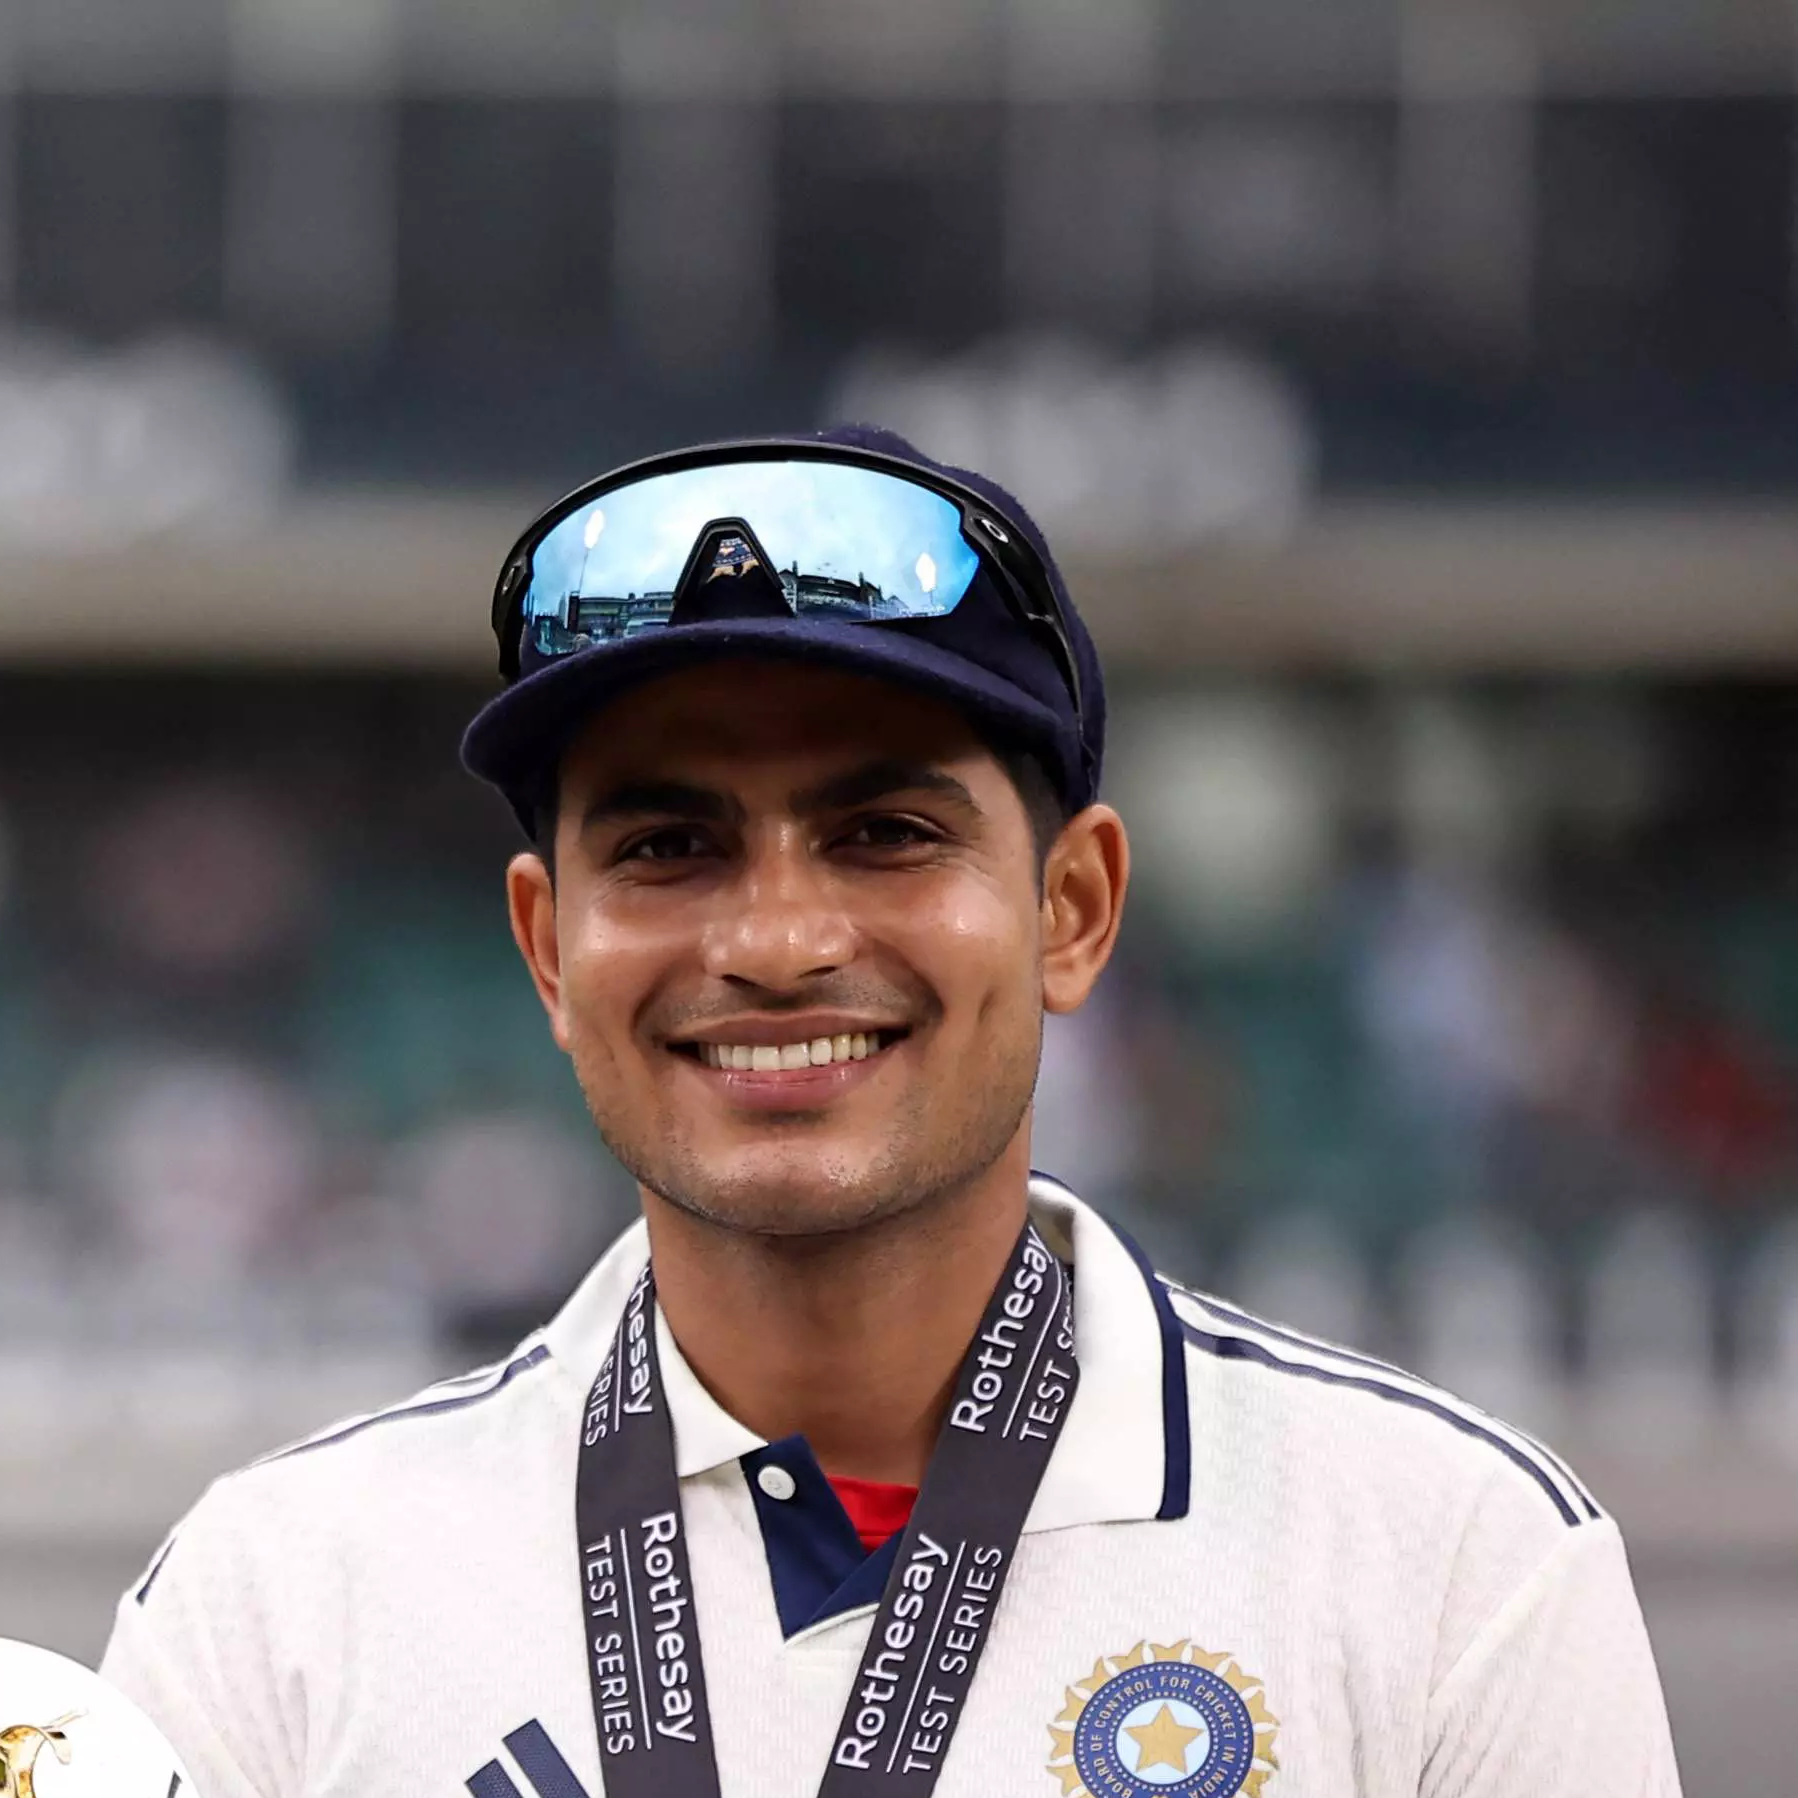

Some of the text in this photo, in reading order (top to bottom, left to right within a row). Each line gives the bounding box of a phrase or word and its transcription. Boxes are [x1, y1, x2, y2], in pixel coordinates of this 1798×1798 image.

[950, 1225, 1054, 1433] Rothesay
[585, 1355, 614, 1446] ERIES
[1019, 1360, 1071, 1441] TEST
[586, 1534, 635, 1755] TEST SERIES
[641, 1512, 697, 1743] Rothesay
[835, 1533, 949, 1770] Rothesay
[903, 1547, 1002, 1774] TEST SERIES
[1095, 1677, 1154, 1729] CONTROL
[1160, 1676, 1190, 1690] FOR
[1194, 1684, 1236, 1740] CRICKET
[1091, 1734, 1103, 1752] OF
[1221, 1744, 1236, 1764] IN
